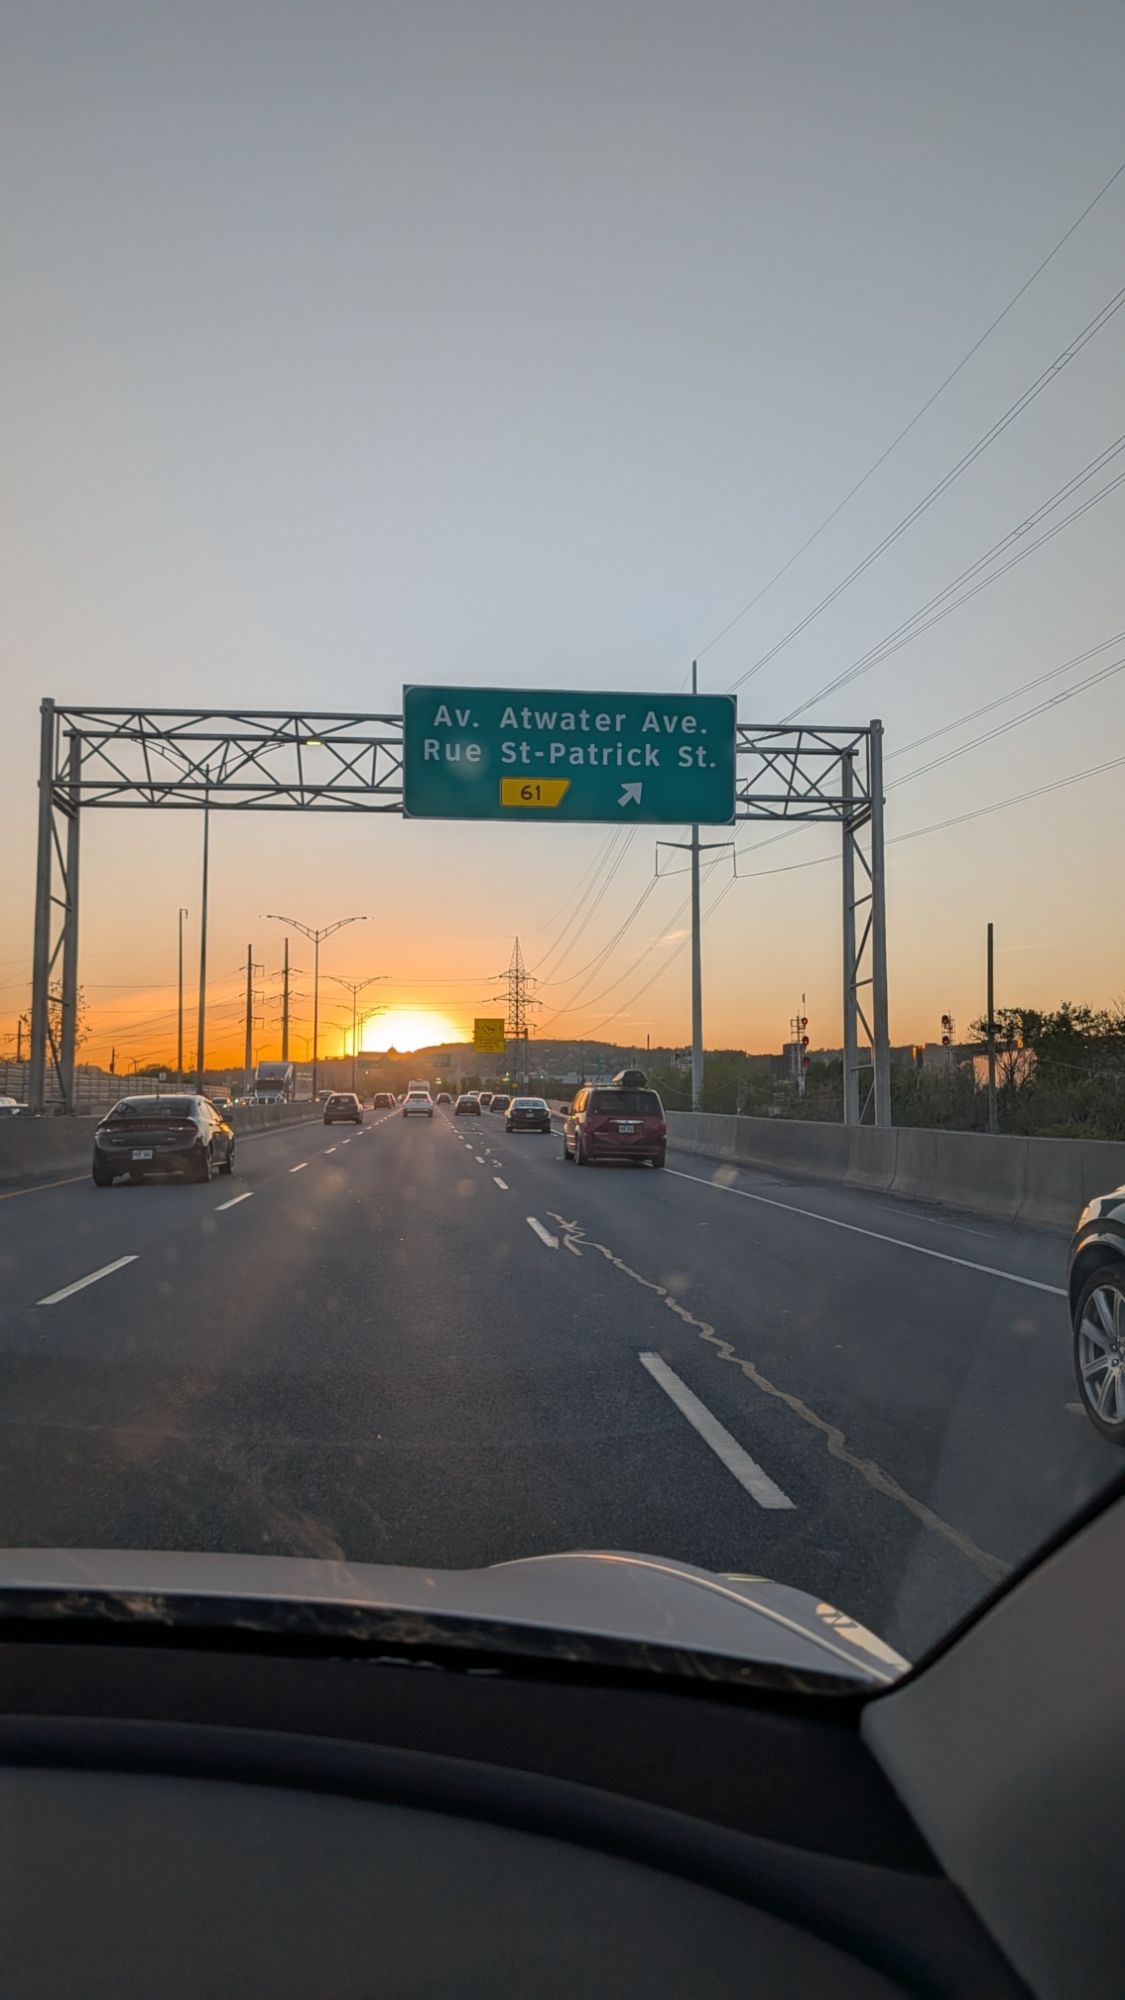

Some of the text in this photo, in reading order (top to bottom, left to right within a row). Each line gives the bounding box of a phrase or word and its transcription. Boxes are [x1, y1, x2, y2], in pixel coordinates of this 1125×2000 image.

[433, 705, 707, 734] Av. Atwater Ave.
[424, 739, 716, 768] Rue St-Patrick St.
[520, 785, 541, 800] 61
